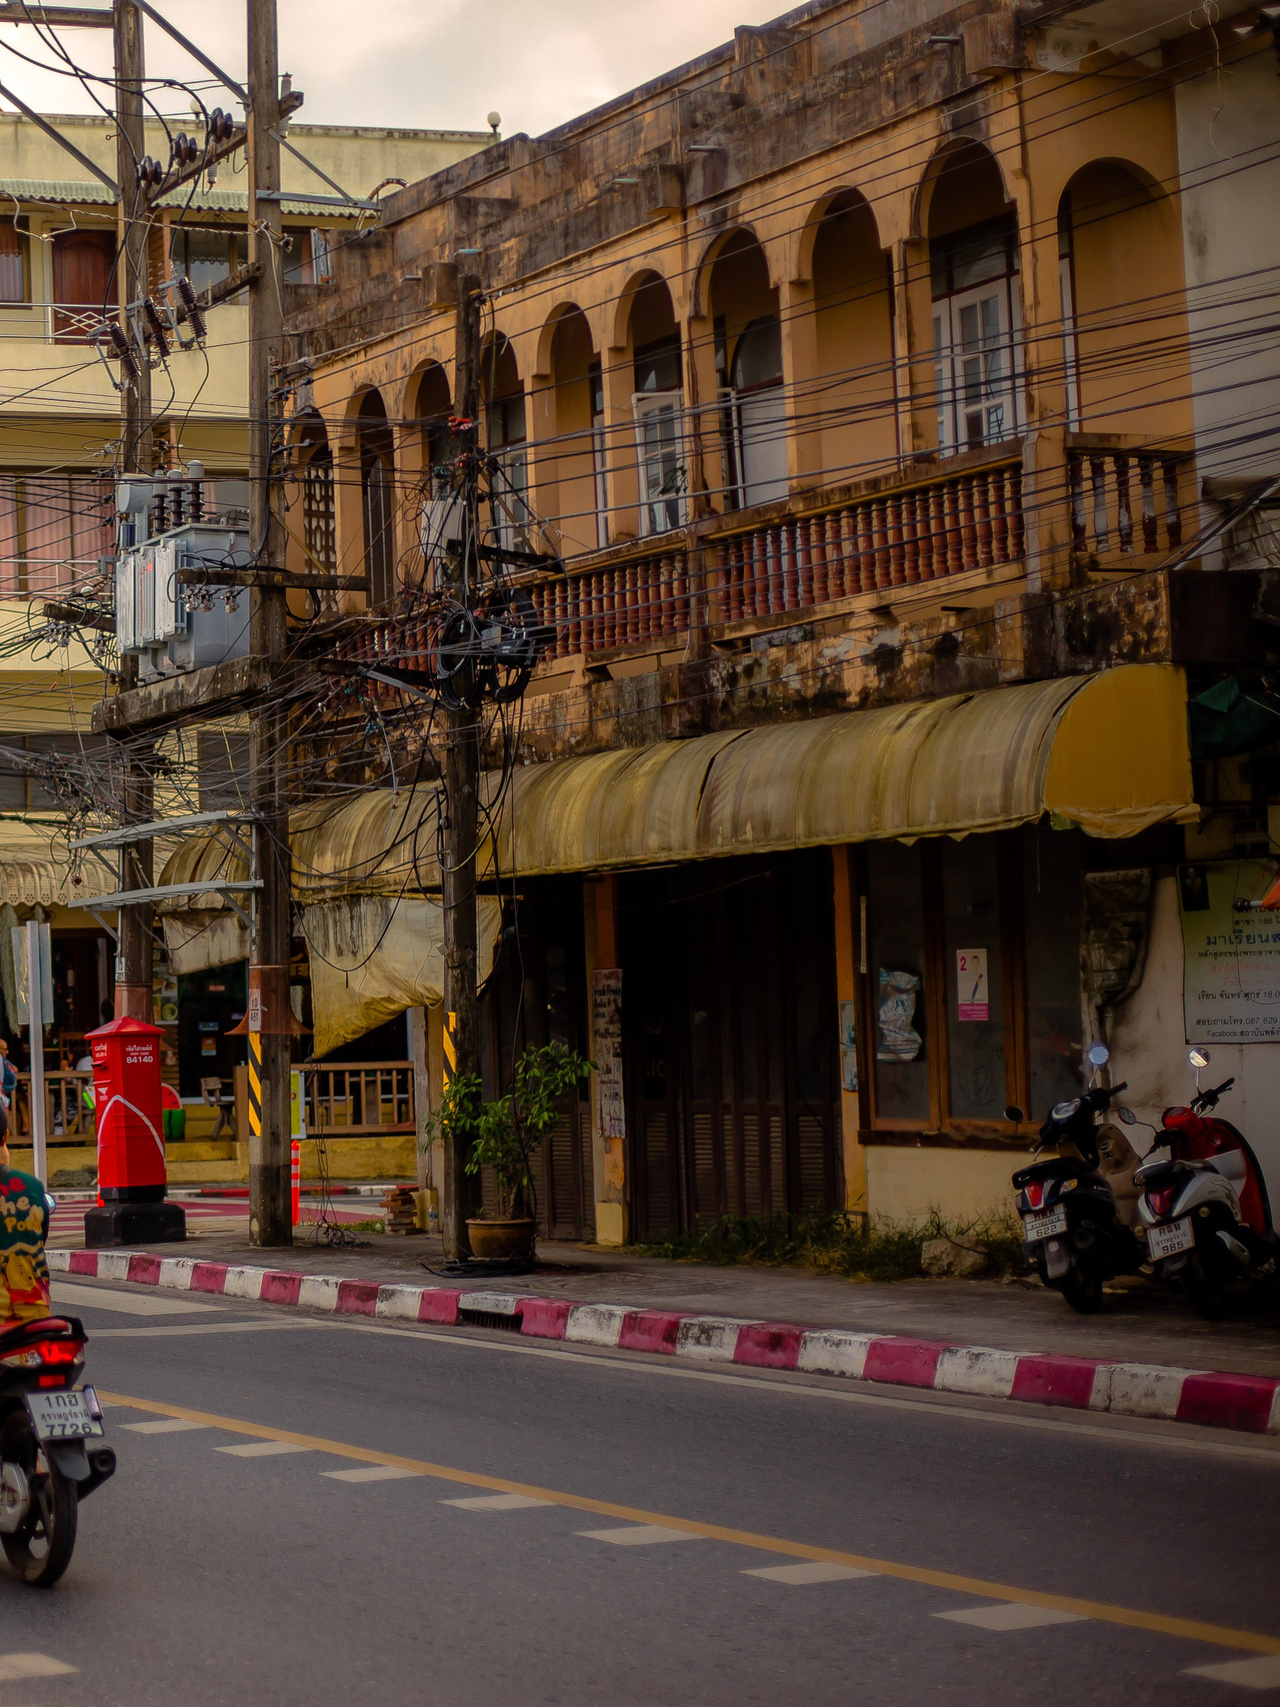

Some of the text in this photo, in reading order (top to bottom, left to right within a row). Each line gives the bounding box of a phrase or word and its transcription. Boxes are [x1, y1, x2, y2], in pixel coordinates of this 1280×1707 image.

[960, 956, 967, 971] 2
[126, 1056, 153, 1064] 84140
[1037, 1224, 1057, 1237] 622
[1162, 1240, 1184, 1254] 985
[45, 1423, 92, 1436] 7726
